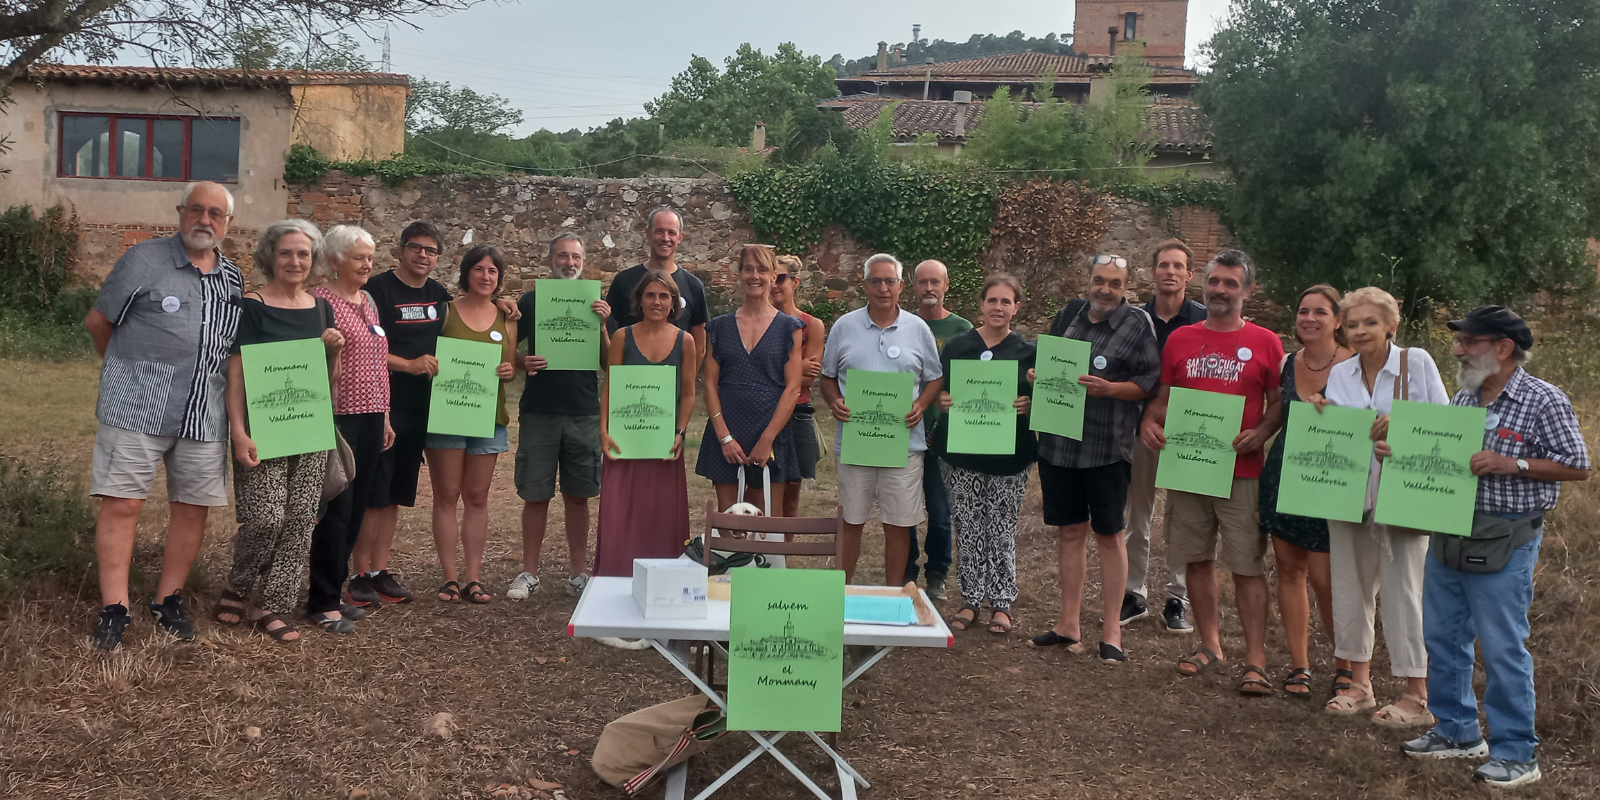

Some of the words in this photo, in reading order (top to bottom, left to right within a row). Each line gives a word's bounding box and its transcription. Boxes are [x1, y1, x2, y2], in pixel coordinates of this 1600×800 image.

[451, 358, 485, 368] Monmany
[1051, 356, 1077, 367] Monmany
[1219, 359, 1246, 372] CUGAT
[264, 364, 308, 373] Monmany
[862, 389, 898, 398] Monmany
[446, 399, 482, 408] Valldoreix
[1047, 397, 1074, 408] Valldoreix
[268, 411, 314, 422] Valldoreix
[1184, 409, 1224, 422] Monmany
[858, 431, 895, 439] Valldoreix
[1308, 426, 1353, 439] Monmany
[1412, 426, 1463, 441] Monmany
[1176, 453, 1218, 464] Valldoreix
[1301, 474, 1348, 486] Valldoreix
[1403, 480, 1456, 495] Valldoreix
[768, 600, 808, 611] salvem
[782, 665, 793, 674] el
[757, 675, 817, 689] Monmany
